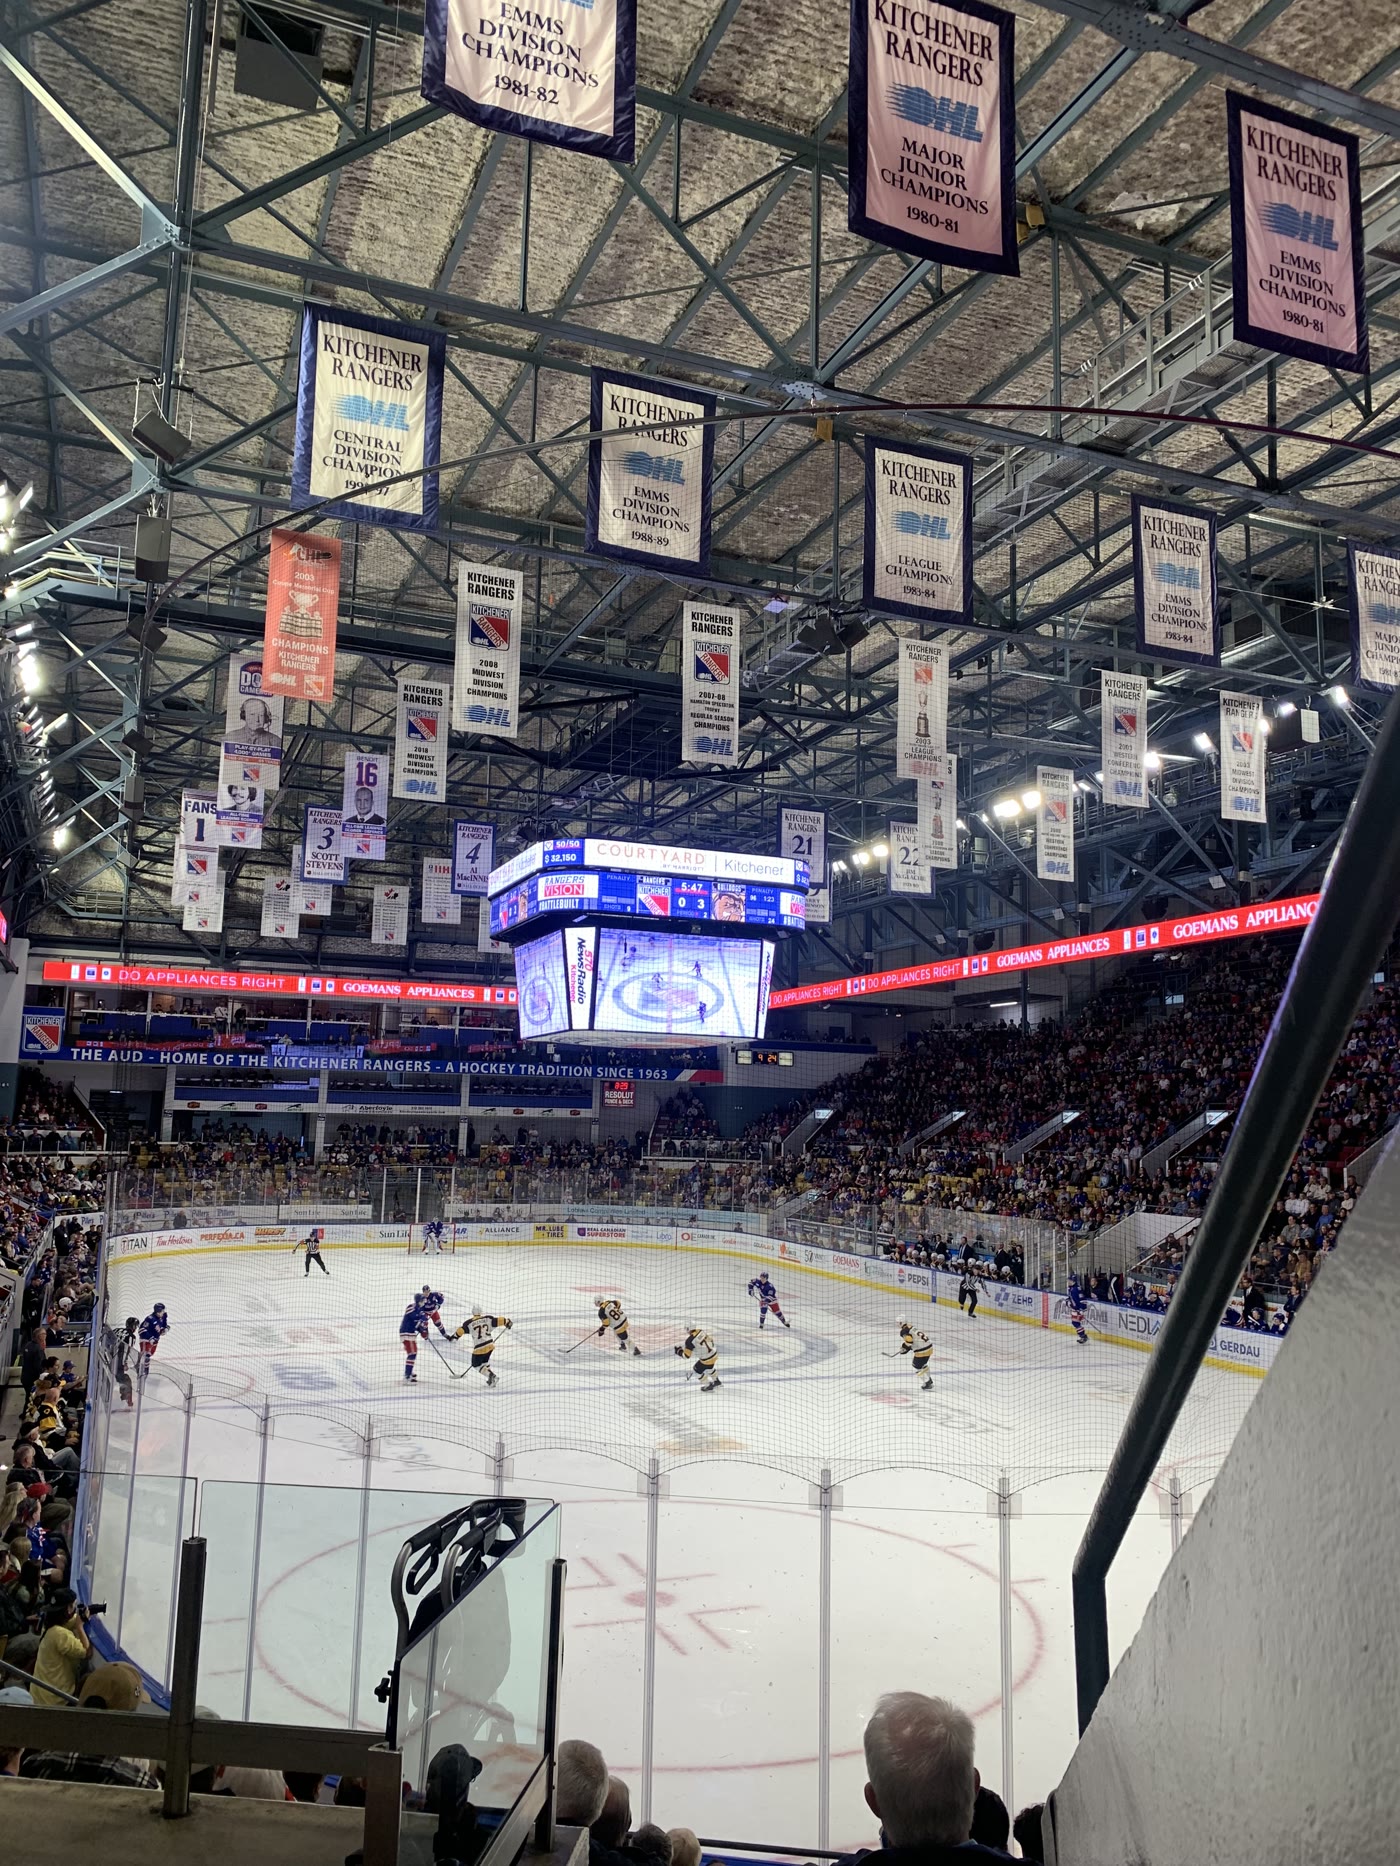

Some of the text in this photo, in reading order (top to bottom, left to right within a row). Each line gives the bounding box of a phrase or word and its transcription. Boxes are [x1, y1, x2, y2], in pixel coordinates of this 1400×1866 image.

[501, 3, 564, 36] EMMS
[874, 0, 994, 61] KITCHENER
[479, 18, 581, 63] DIVISION
[462, 33, 599, 88] CHAMPIONS
[886, 30, 983, 87] RANGERS
[494, 74, 560, 105] 1981-82
[902, 136, 965, 171] MAJOR
[1246, 125, 1344, 179] KITCHENER
[898, 155, 968, 191] JUNIOR
[1257, 154, 1336, 201] RANGERS
[881, 168, 989, 215] CHAMPIONS
[906, 205, 959, 234] 1980-81
[1280, 250, 1322, 275] EMMS
[1269, 264, 1334, 296] DIVISION
[1259, 278, 1346, 318] CHAMPIONS
[1282, 309, 1324, 333] 1980-81
[323, 334, 422, 373] KITCHENER
[332, 357, 413, 391] RANGERS
[334, 429, 404, 453] CENTRAL
[334, 444, 402, 466] DIVISION
[882, 458, 957, 489] KITCHENER
[634, 486, 670, 503] EMMS
[889, 479, 951, 506] RANGERS
[623, 497, 680, 518] DIVISION
[612, 508, 690, 533] CHAMPIONS
[1143, 515, 1207, 542] KITCHENER
[631, 530, 670, 547] 1988-89
[1150, 533, 1202, 558] RANGERS
[898, 554, 942, 571] LEAGUE
[294, 572, 315, 582] 2003
[467, 571, 515, 589] KITCHENER
[885, 564, 953, 585] CHAMPIONS
[322, 585, 335, 595] Cup
[467, 583, 515, 601] RANGERS
[903, 585, 936, 599] 1983-84
[1165, 593, 1192, 607] EMMS
[472, 603, 510, 618] KITCHENER
[691, 611, 733, 626] KITCHENER
[1158, 603, 1200, 618] DIVISION
[691, 621, 733, 637] RANGERS
[1151, 613, 1208, 631] CHAMPIONS
[476, 616, 505, 648] RANGERS
[1165, 631, 1193, 644] 1983-84
[272, 637, 329, 654] CHAMPIONS
[696, 642, 729, 653] KITCHENER
[906, 644, 942, 656] KITCHENER
[278, 650, 320, 664] KITCHENER
[281, 659, 316, 671] RANGERS
[479, 659, 498, 669] 2008
[908, 652, 939, 664] RANGERS
[472, 668, 505, 679] MIDWEST
[700, 653, 726, 682] RANGERS
[403, 684, 443, 697] KITCHENER
[472, 678, 504, 689] DIVISION
[403, 692, 443, 707] RANGERS
[467, 687, 508, 701] CHAMPIONS
[1107, 688, 1141, 701] RANGERS
[694, 722, 730, 732] CHAMPIONS
[407, 753, 435, 761] MIDWEST
[904, 752, 942, 762] CHAMPIONS
[911, 746, 934, 755] LEAGUE
[402, 767, 438, 777] CHAMPIONS
[407, 761, 434, 769] DIVISION
[356, 761, 378, 788] 16
[185, 800, 217, 814] FANS
[312, 817, 342, 826] RANGERS
[785, 813, 821, 825] KITCHENER
[195, 818, 205, 842] 1
[458, 825, 492, 834] KITCHENER
[461, 832, 488, 840] RANGERS
[788, 822, 818, 834] RANGERS
[317, 827, 335, 850] 3
[555, 840, 580, 849] 50/50
[792, 835, 813, 856] 21
[311, 851, 340, 861] SCOTT
[465, 842, 482, 864] 4
[544, 854, 577, 864] $ 32,150
[597, 843, 784, 876] COURTYARD Kitchener
[306, 860, 344, 870] STEVENS
[672, 864, 704, 872] MARRIOTT
[545, 875, 585, 885] RANGERS
[681, 882, 703, 893] 5:47
[544, 884, 584, 896] VISION
[639, 885, 669, 896] KITCHENER
[678, 897, 705, 909] 0 3
[1173, 915, 1239, 940] GOEMANS
[584, 950, 593, 972] 570
[996, 938, 1110, 967] GOEMANS APPLIANCES
[119, 970, 285, 989] DO APPLIANCES RIGHT
[577, 936, 587, 1006] NewsRadio
[867, 963, 960, 989] DO APPLIANCES RIGHT
[343, 982, 475, 999] GOEMANS APPLIANCES
[773, 984, 843, 1005] DO APPLIANCES RIGHT
[26, 1016, 61, 1026] KITCHENER
[30, 1024, 57, 1050] RANGERS
[71, 1048, 668, 1080] THE AUD HOME OF THE KITCHENER RANGERS A HOCKEY TRADITION SINCE 1963
[605, 1091, 634, 1099] RESOLUT
[358, 1104, 393, 1112] Aberfoyle
[379, 1230, 395, 1239] Sun
[484, 1226, 520, 1234] ALLIANCE
[155, 1235, 193, 1247] Tim Hortons
[832, 1254, 860, 1268] GOEMANS
[907, 1273, 929, 1286] PEPSI
[1012, 1293, 1033, 1307] ZEHR
[1220, 1339, 1260, 1358] GERDAU
